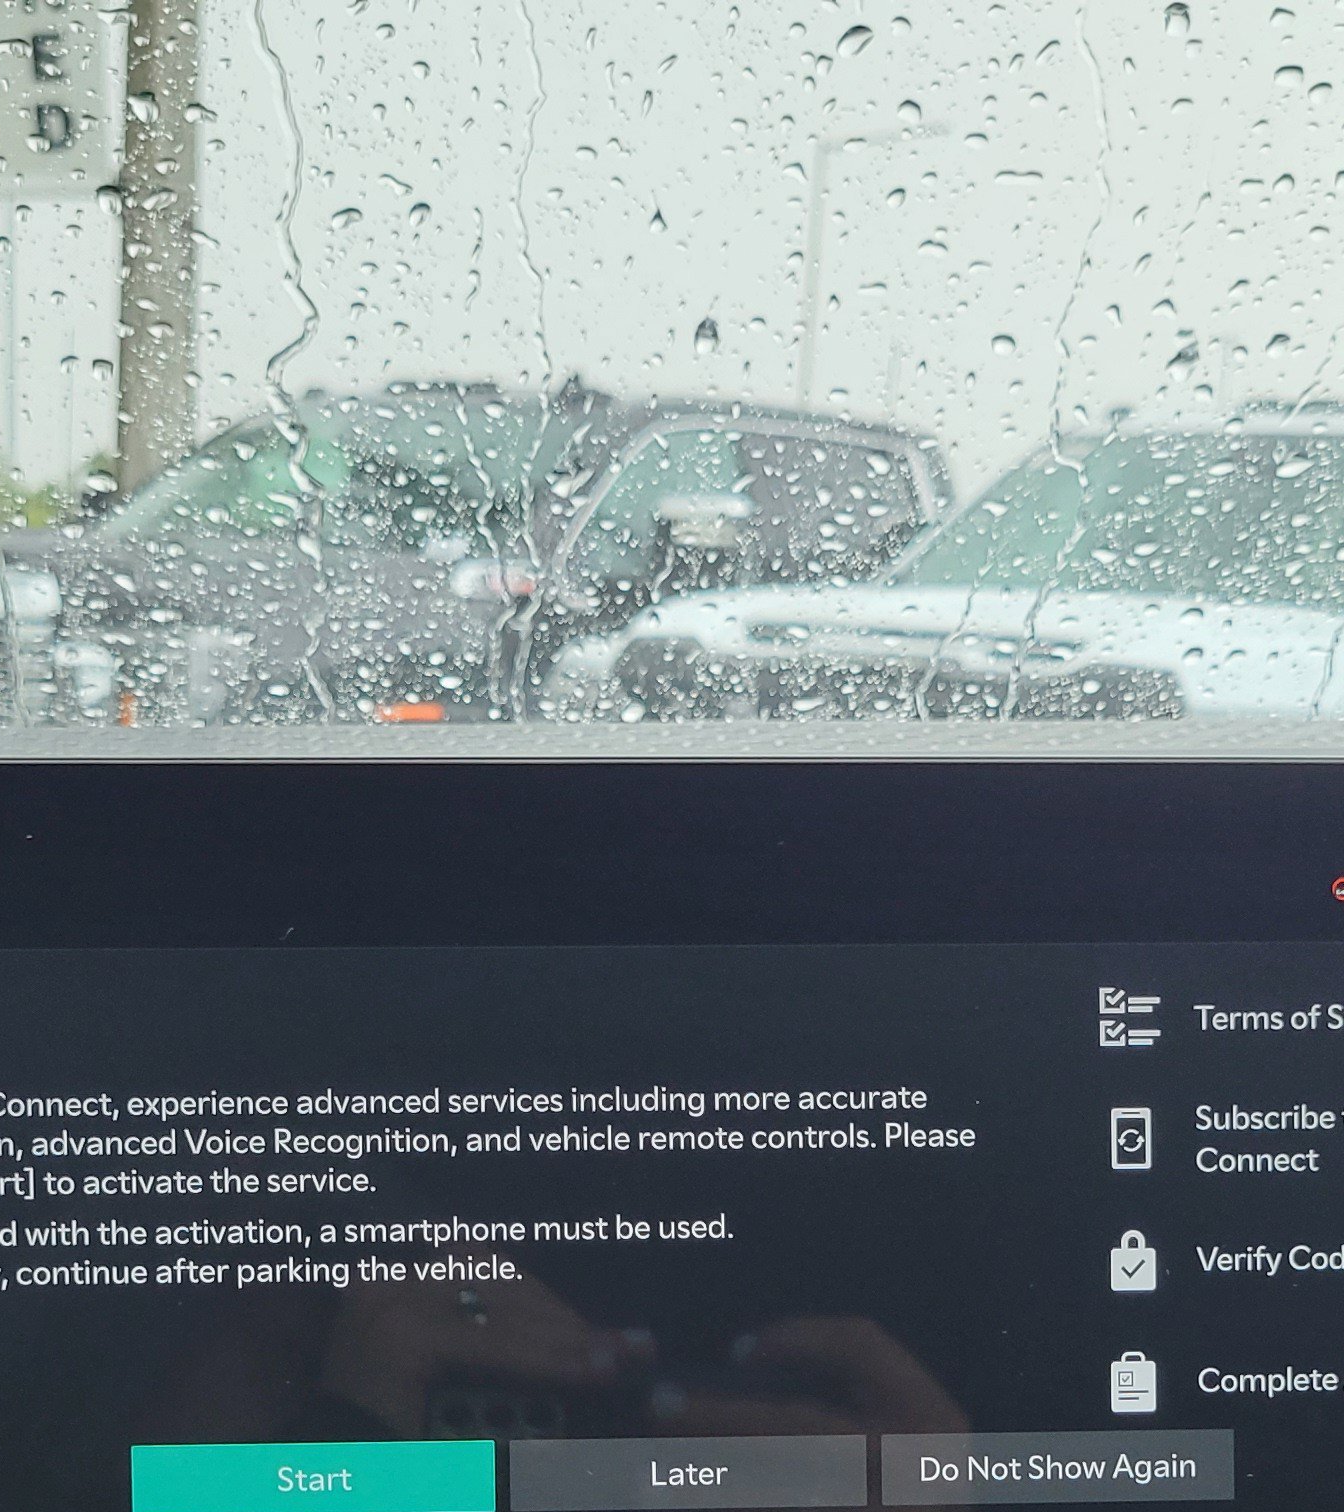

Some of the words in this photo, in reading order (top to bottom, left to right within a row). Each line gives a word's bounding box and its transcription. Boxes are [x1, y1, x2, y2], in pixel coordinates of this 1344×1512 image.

[1193, 1004, 1285, 1031] Terms
[1290, 1003, 1322, 1030] of
[127, 1089, 289, 1122] experience
[296, 1087, 440, 1115] advanced
[448, 1087, 564, 1114] services
[571, 1085, 705, 1118] including
[714, 1091, 791, 1111] more
[798, 1086, 928, 1110] accurate
[1195, 1103, 1336, 1131] Subscribe
[31, 1128, 177, 1156] advanced
[183, 1128, 266, 1155] Voice
[274, 1127, 458, 1160] Recognition,
[466, 1125, 521, 1152] and
[528, 1124, 631, 1152] vehicle
[638, 1126, 744, 1151] remote
[751, 1122, 877, 1150] controls.
[885, 1121, 976, 1148] Please
[1195, 1146, 1320, 1173] Connect
[42, 1172, 75, 1195] to
[83, 1169, 203, 1195] activate
[209, 1166, 260, 1194] the
[266, 1167, 377, 1193] service.
[24, 1219, 90, 1247] with
[96, 1218, 148, 1246] the
[155, 1218, 311, 1249] activation,
[319, 1224, 337, 1243] a
[344, 1215, 526, 1248] smartphone
[534, 1217, 609, 1241] must
[615, 1213, 651, 1240] be
[659, 1212, 734, 1240] used.
[16, 1259, 148, 1286] continue
[155, 1257, 230, 1284] after
[237, 1256, 350, 1290] parking
[356, 1255, 407, 1282] the
[413, 1253, 523, 1281] vehicle.
[1196, 1245, 1283, 1277] Verify
[1198, 1365, 1340, 1399] Complete
[277, 1466, 353, 1492] Start
[651, 1460, 729, 1487] Later
[920, 1456, 959, 1482] Do
[967, 1455, 1022, 1481] Not
[1028, 1454, 1106, 1480] Show
[1112, 1453, 1196, 1485] Again
